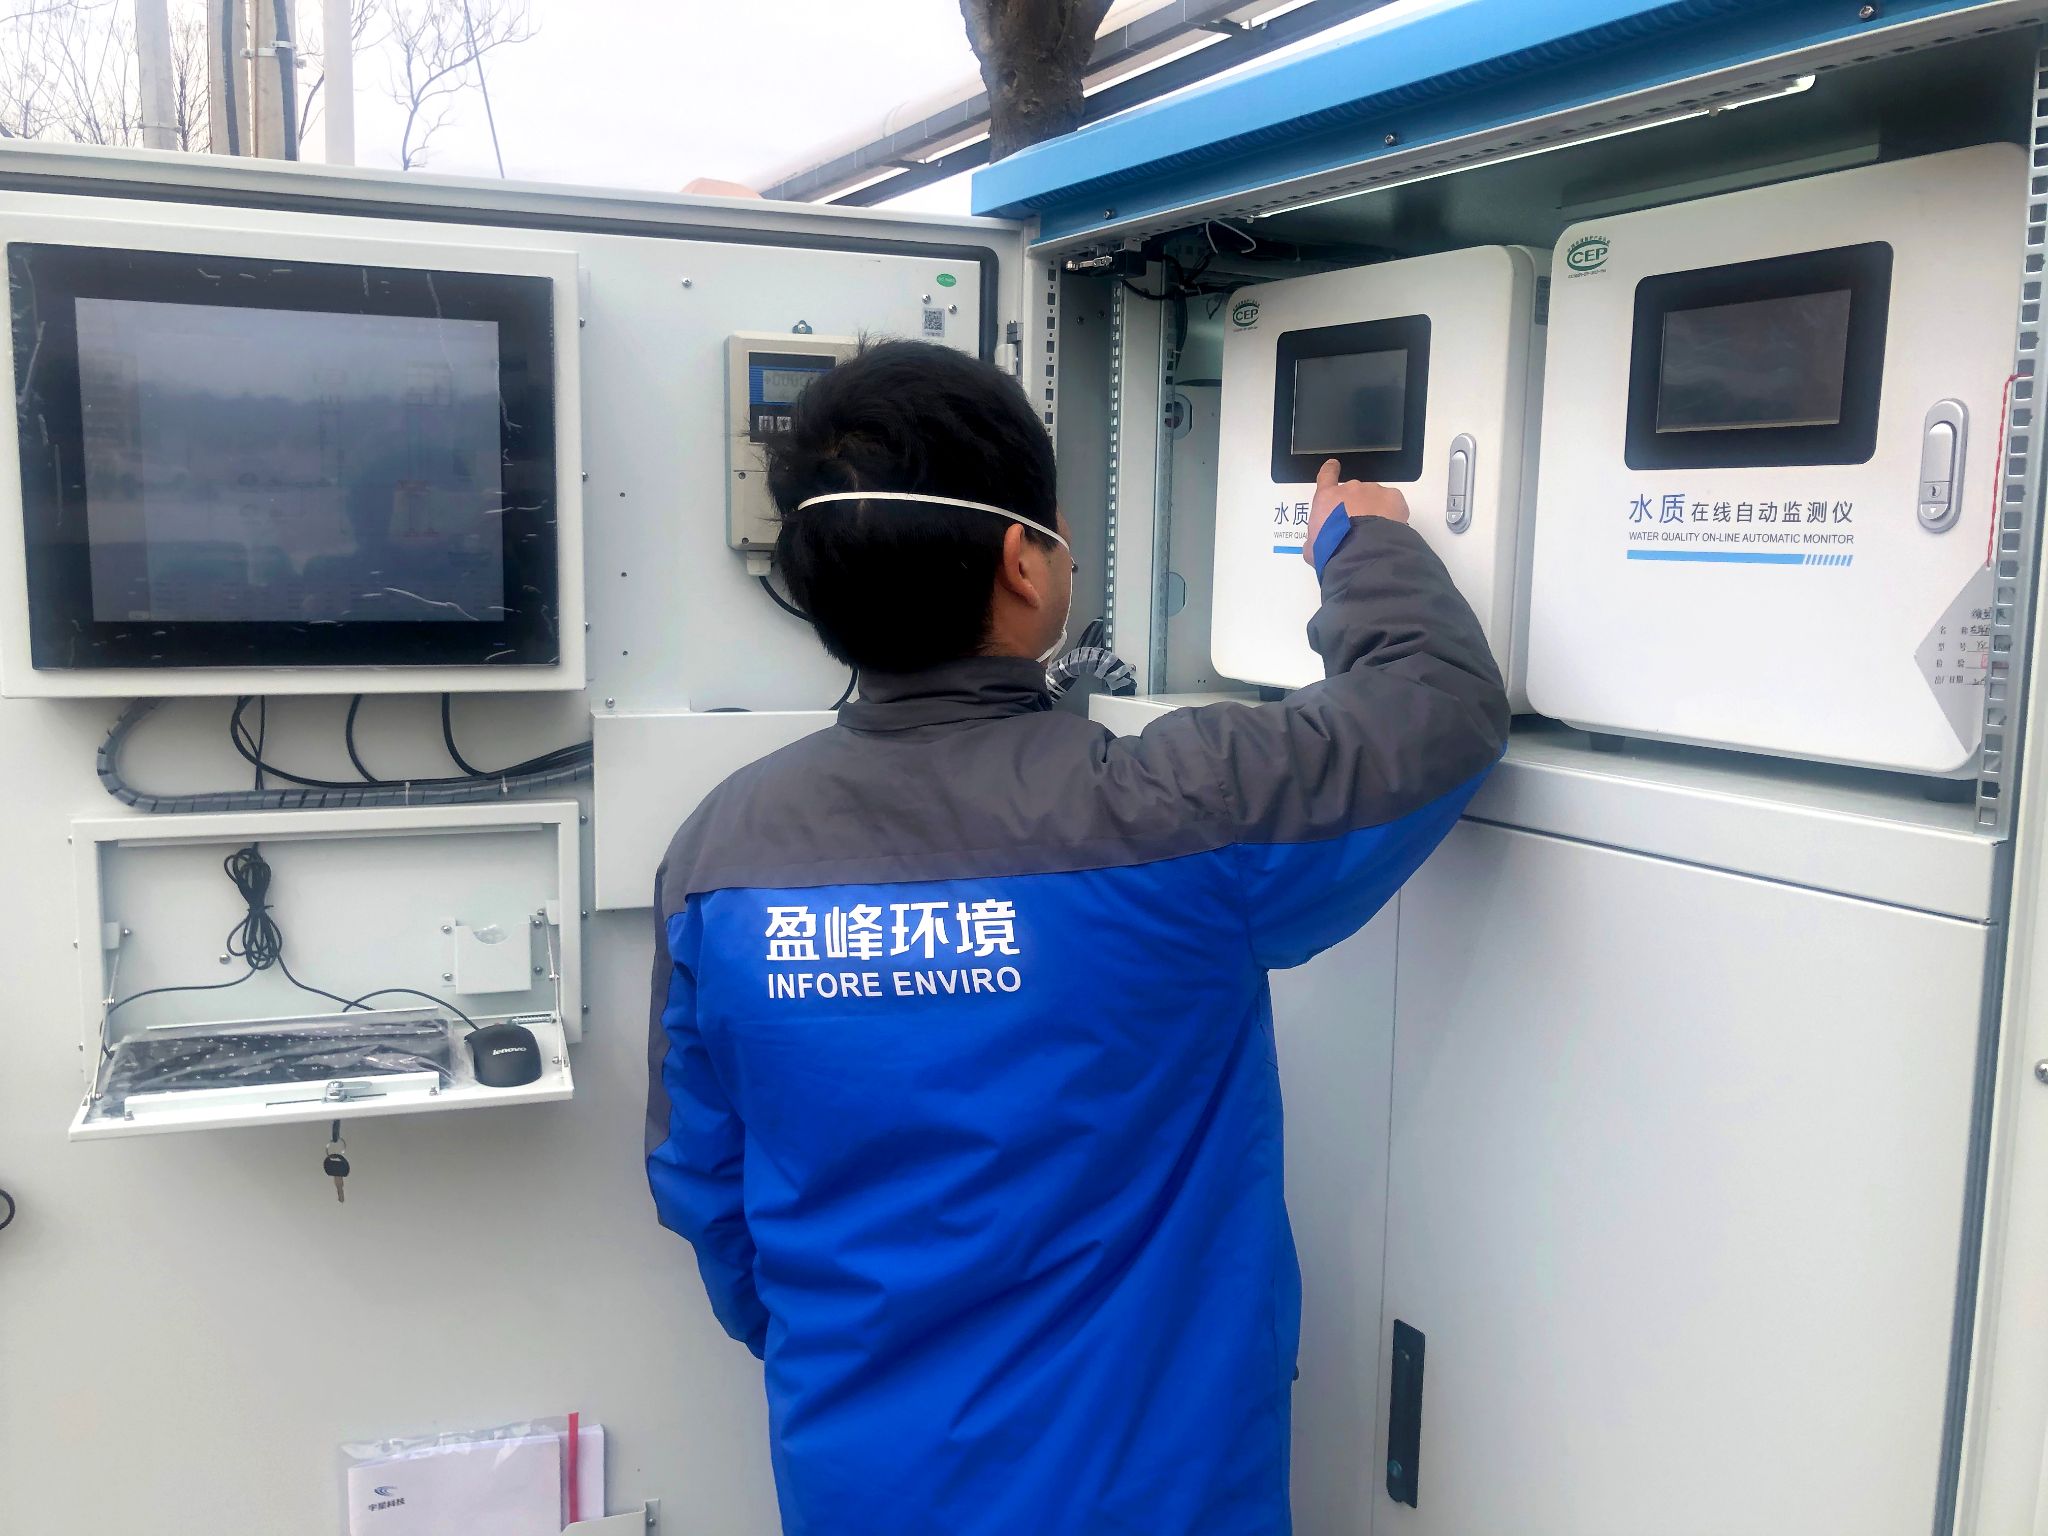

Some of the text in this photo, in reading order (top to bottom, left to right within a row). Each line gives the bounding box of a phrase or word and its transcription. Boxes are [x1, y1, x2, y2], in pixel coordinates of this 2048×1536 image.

[1571, 247, 1608, 264] CEP
[1235, 308, 1259, 321] CEP
[1628, 493, 1853, 524] 水质在线自动监测仪
[1273, 531, 1293, 539] WATER
[1629, 531, 1854, 544] WATER QUALITY ON-LINE AUTOMATIC MONITOR
[764, 898, 1021, 961] 盈峰环境
[767, 966, 1021, 999] INFORE ENVIRO
[492, 1046, 527, 1056] lenovo
